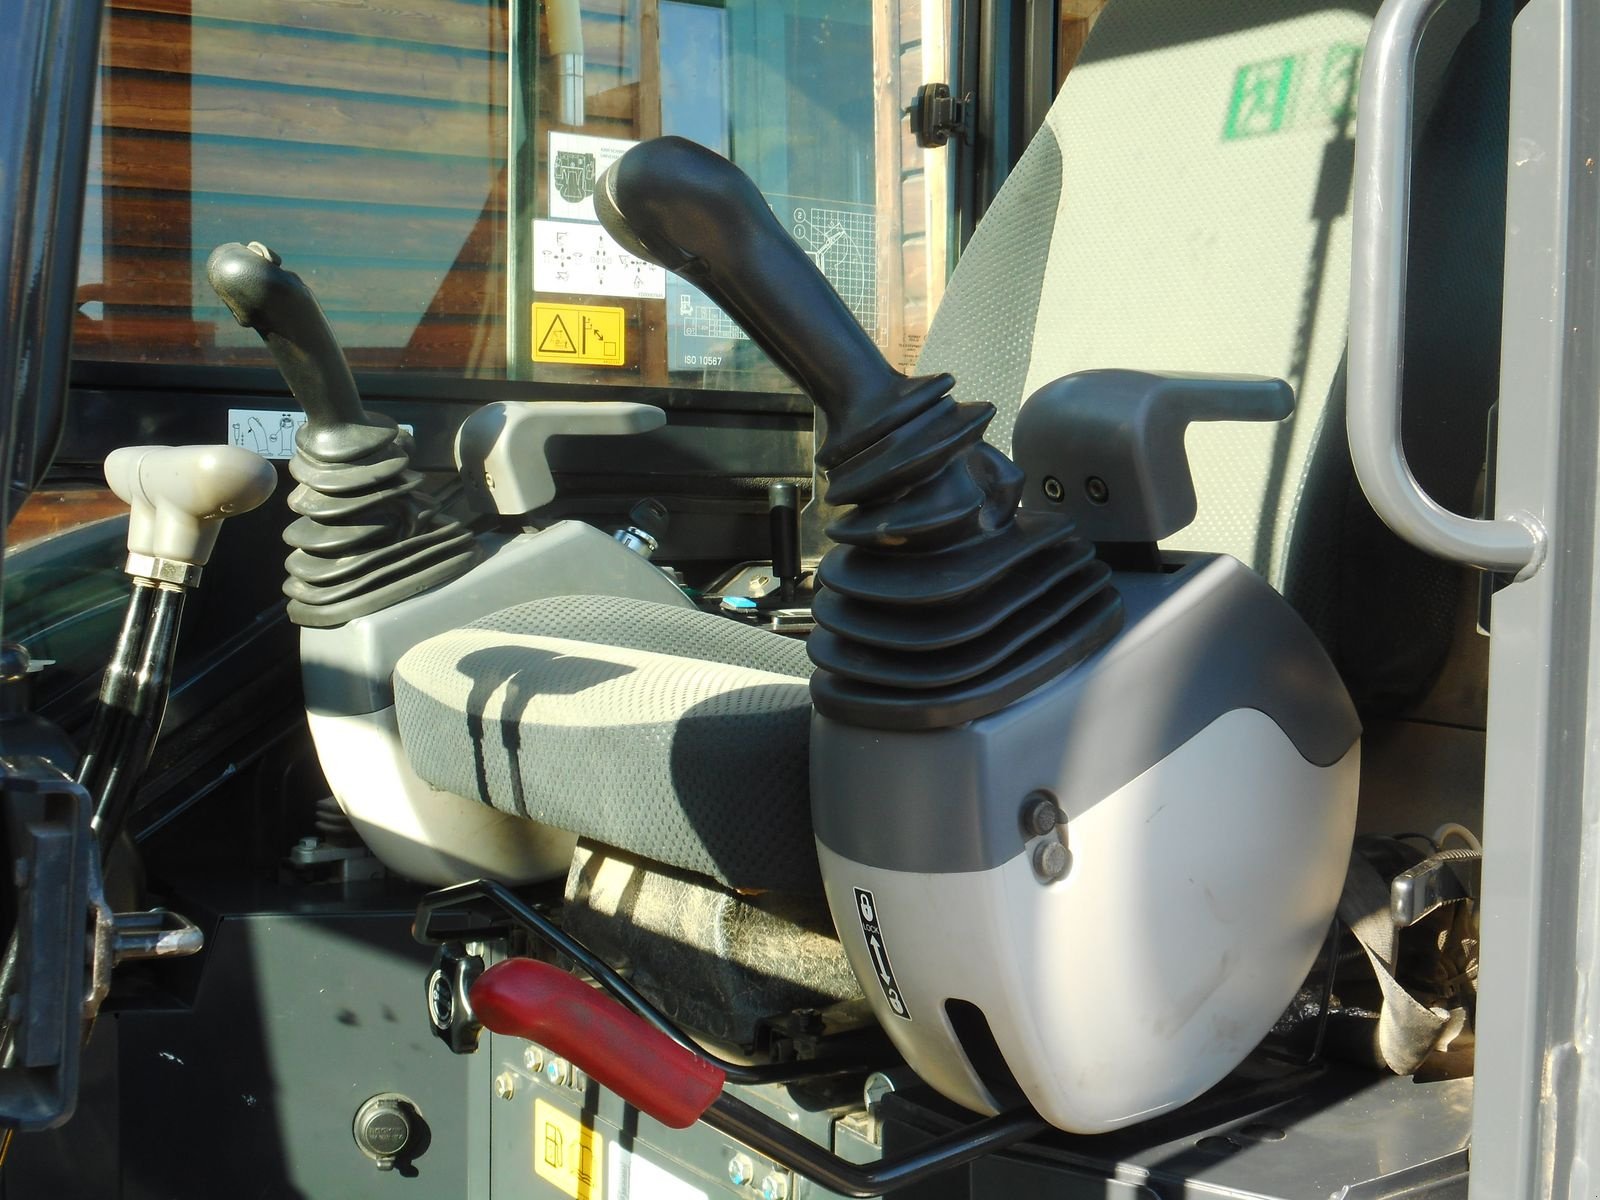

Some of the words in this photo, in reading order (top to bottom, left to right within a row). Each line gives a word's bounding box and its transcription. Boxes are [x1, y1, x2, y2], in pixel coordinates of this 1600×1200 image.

[684, 355, 697, 365] ISO
[699, 356, 722, 366] 10567
[862, 922, 880, 935] LOCK
